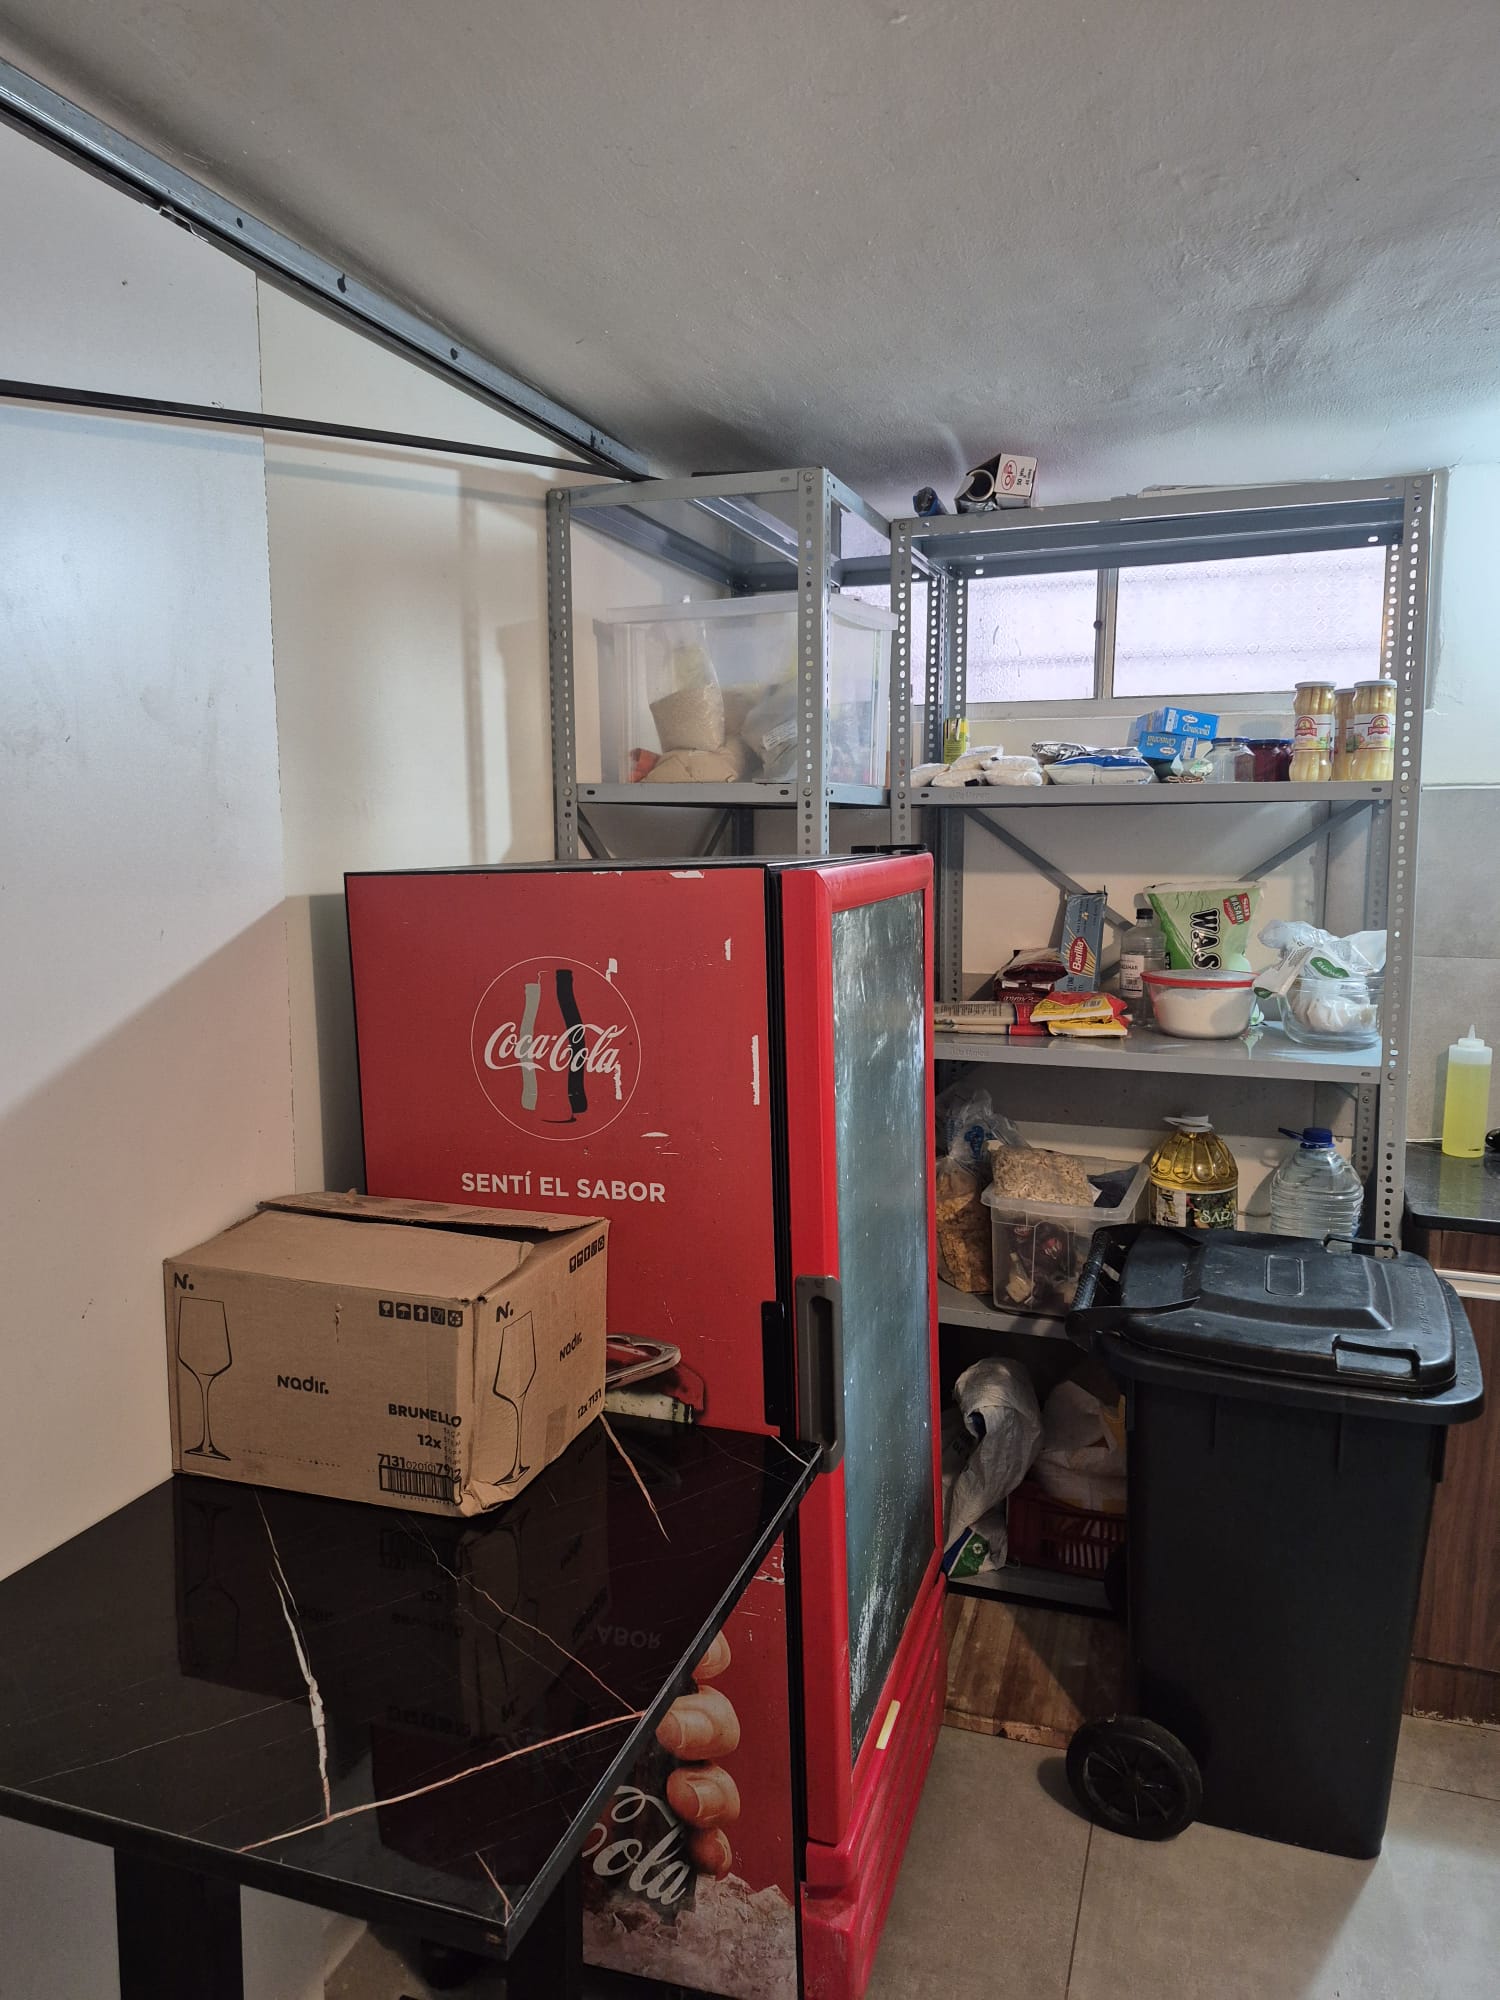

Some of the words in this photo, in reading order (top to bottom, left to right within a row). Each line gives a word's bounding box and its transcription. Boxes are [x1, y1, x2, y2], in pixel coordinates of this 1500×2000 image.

[1190, 908, 1222, 970] WAS
[1072, 941, 1085, 971] Barilla
[484, 1021, 628, 1074] Coca-Cola
[461, 1170, 532, 1195] SENTÍ
[539, 1176, 570, 1198] EL
[576, 1178, 667, 1203] SABOR
[276, 1374, 330, 1395] Nadir.
[388, 1403, 462, 1428] BRUNELLO
[577, 1403, 588, 1420] 12x
[587, 1388, 602, 1409] 7131
[416, 1433, 442, 1450] 12x
